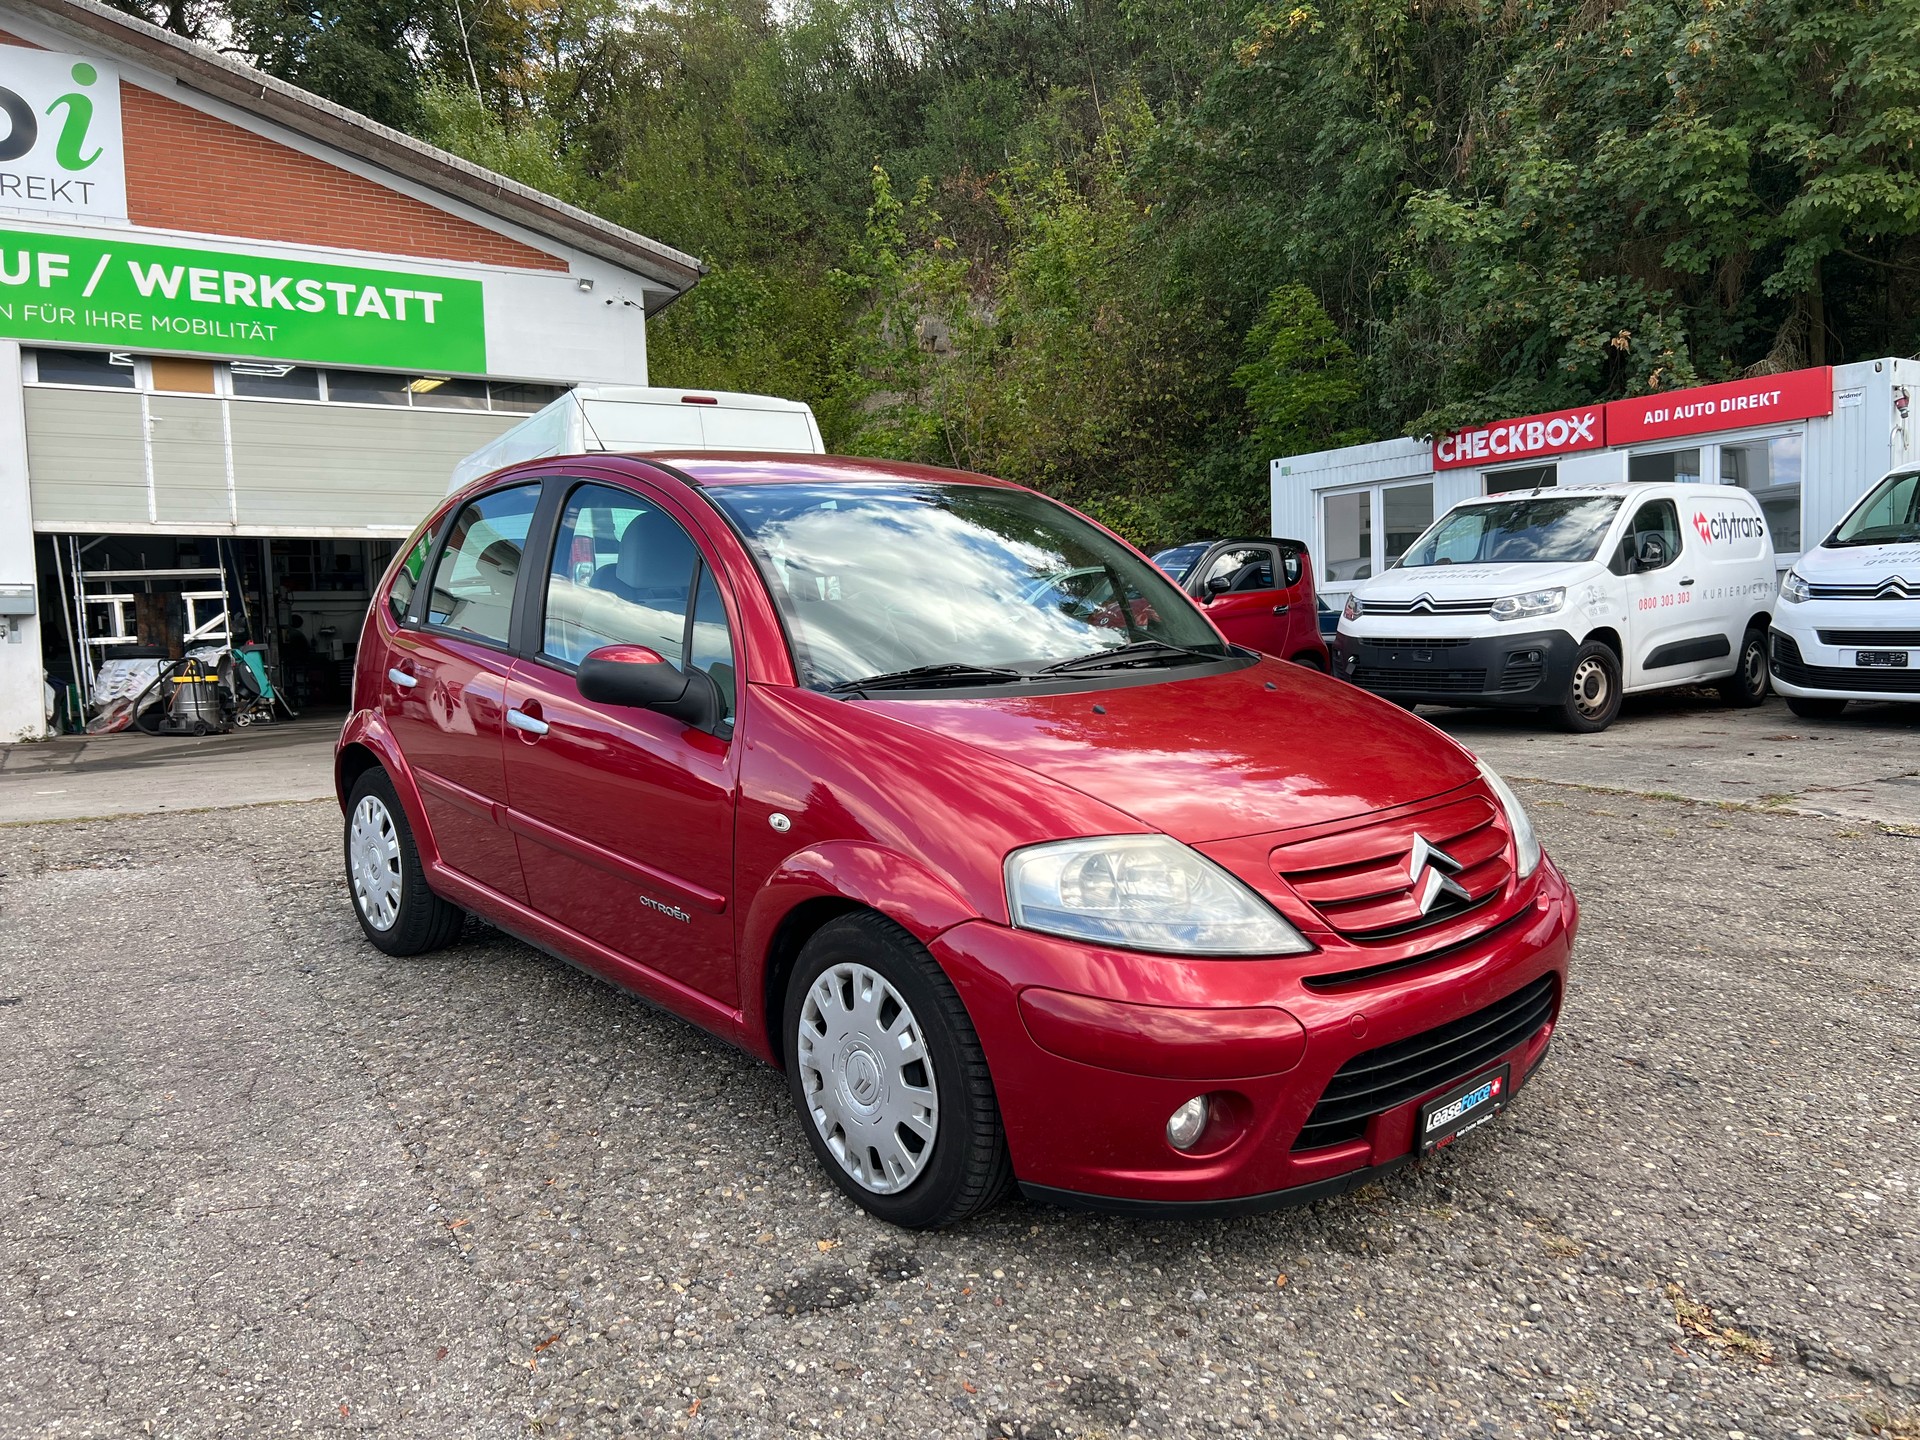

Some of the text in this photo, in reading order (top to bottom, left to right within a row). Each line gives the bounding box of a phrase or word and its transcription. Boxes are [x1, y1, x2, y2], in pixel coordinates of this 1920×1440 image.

[0, 173, 95, 204] REKT
[0, 250, 443, 324] UF / WERKSTATT
[24, 303, 76, 325] FÜR
[85, 309, 144, 331] IHRE
[152, 315, 278, 341] MOBILITÄT
[1643, 390, 1781, 424] ADI AUTO DIREKT
[1437, 412, 1596, 463] CHECKBOX
[1710, 511, 1764, 545] citytrans
[1638, 591, 1690, 611] 0800 303 303
[1702, 581, 1777, 600] KURIERDIENSTE
